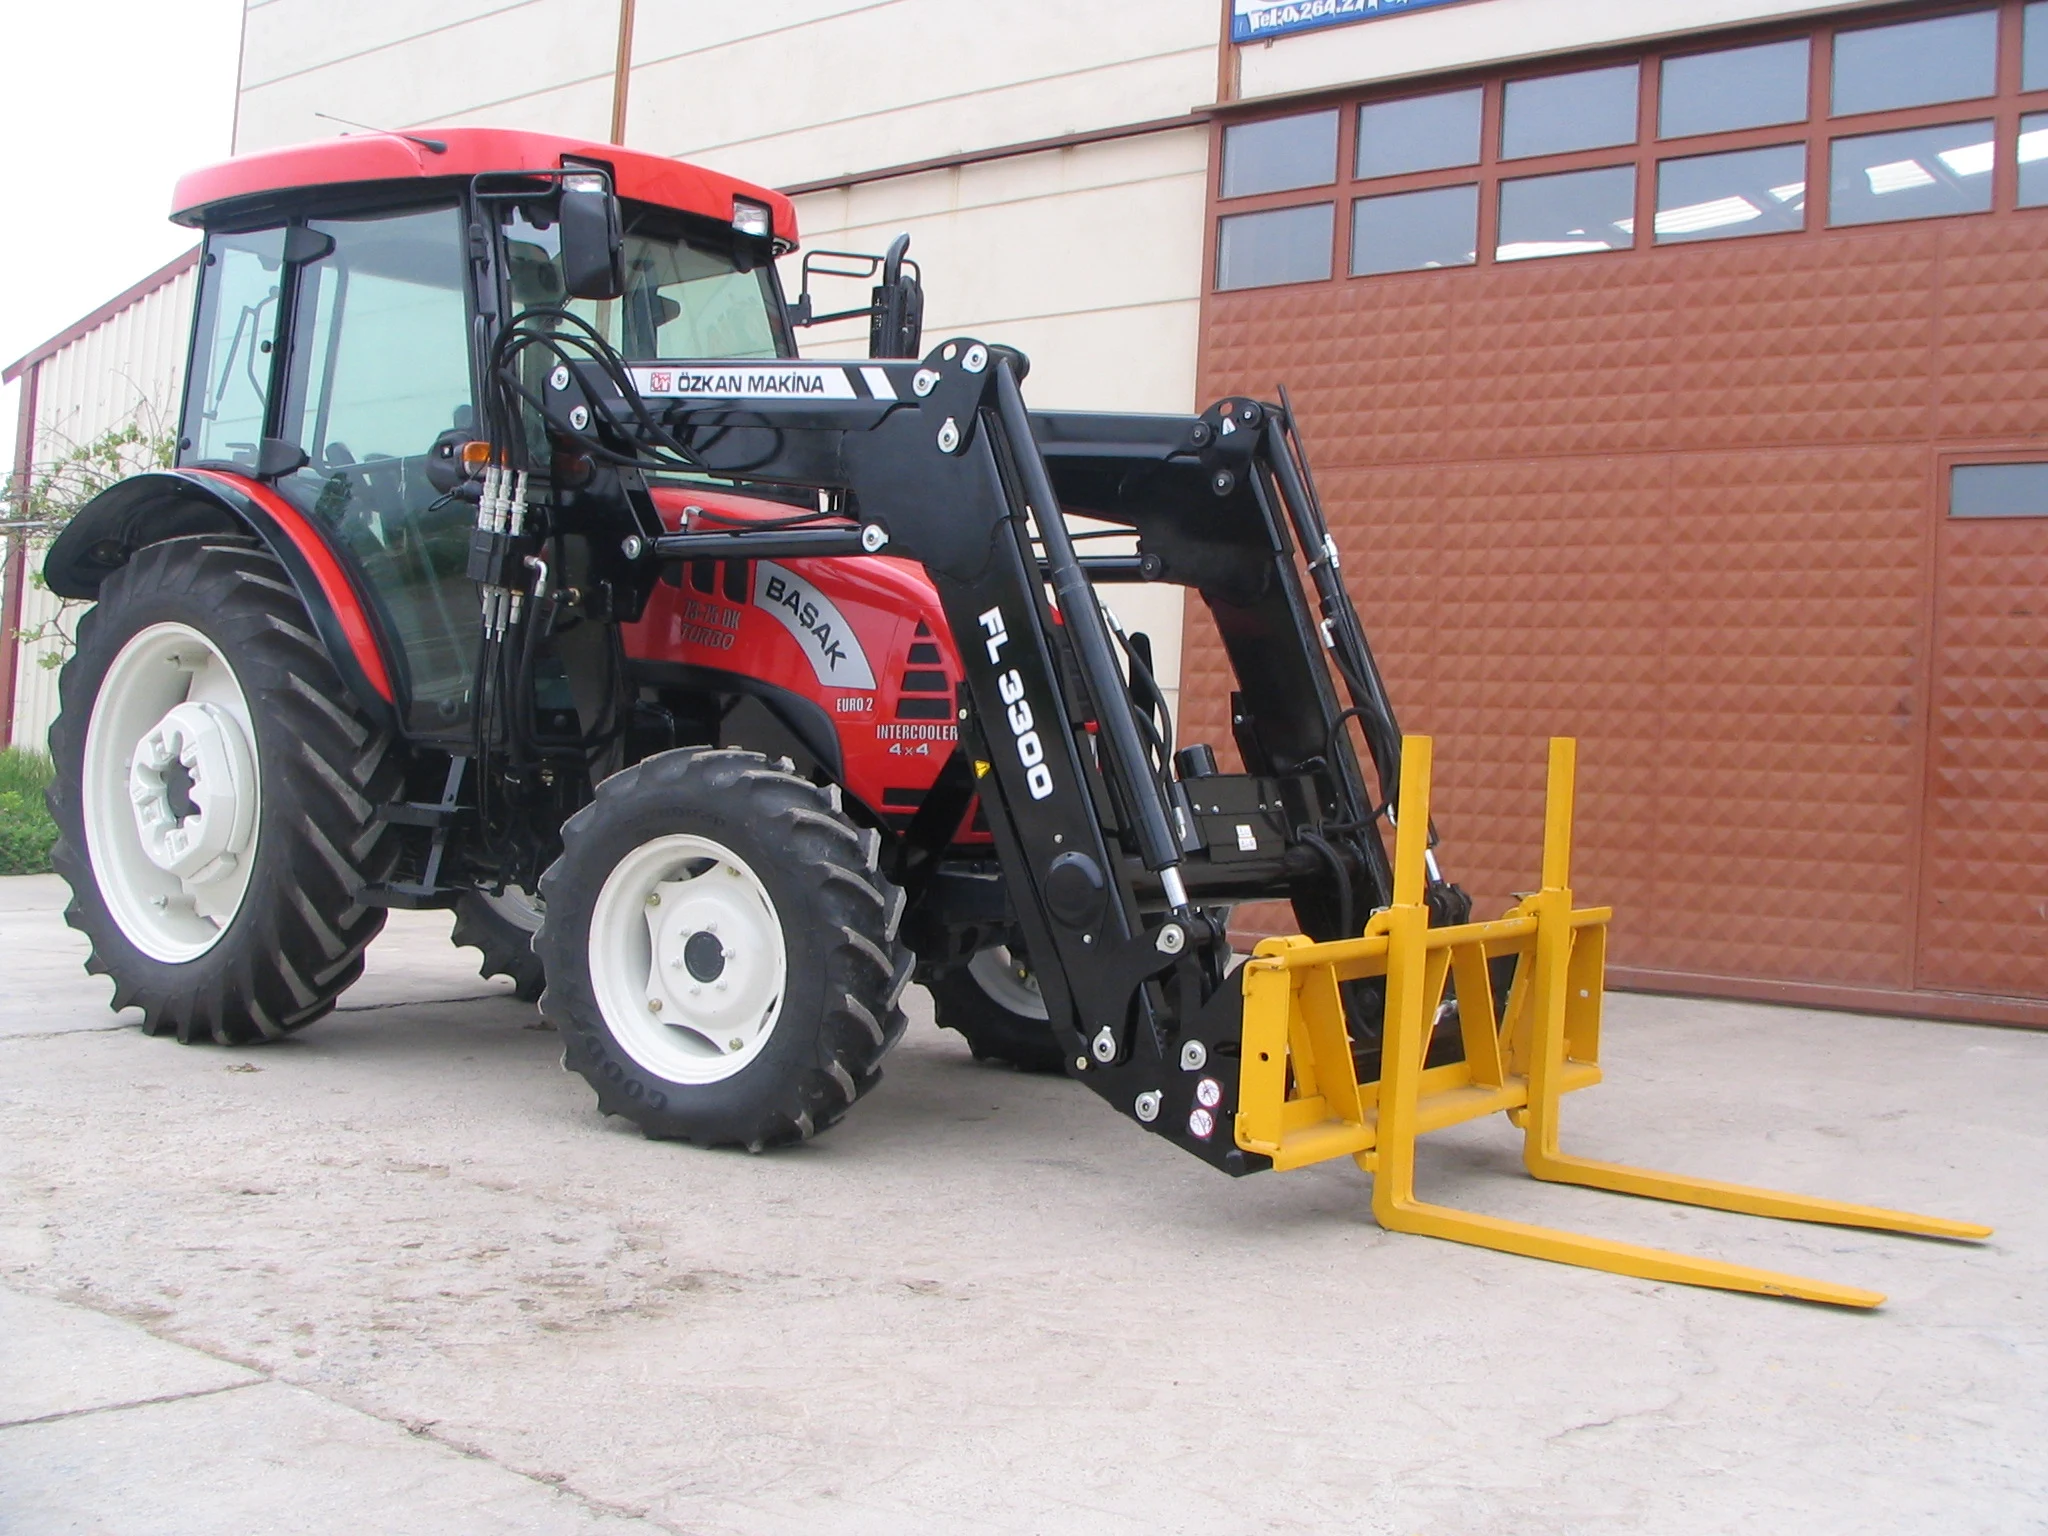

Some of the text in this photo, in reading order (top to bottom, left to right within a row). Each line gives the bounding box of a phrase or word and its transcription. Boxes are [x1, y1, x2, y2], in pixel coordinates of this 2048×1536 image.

[677, 371, 742, 393] ÖZKAN
[747, 371, 825, 393] MAKİNA
[766, 575, 847, 672] BAŞAK
[681, 622, 736, 651] TURBO
[836, 697, 874, 712] EURO 2
[978, 606, 1054, 800] FL 3300
[876, 724, 959, 741] INTERCOOLER
